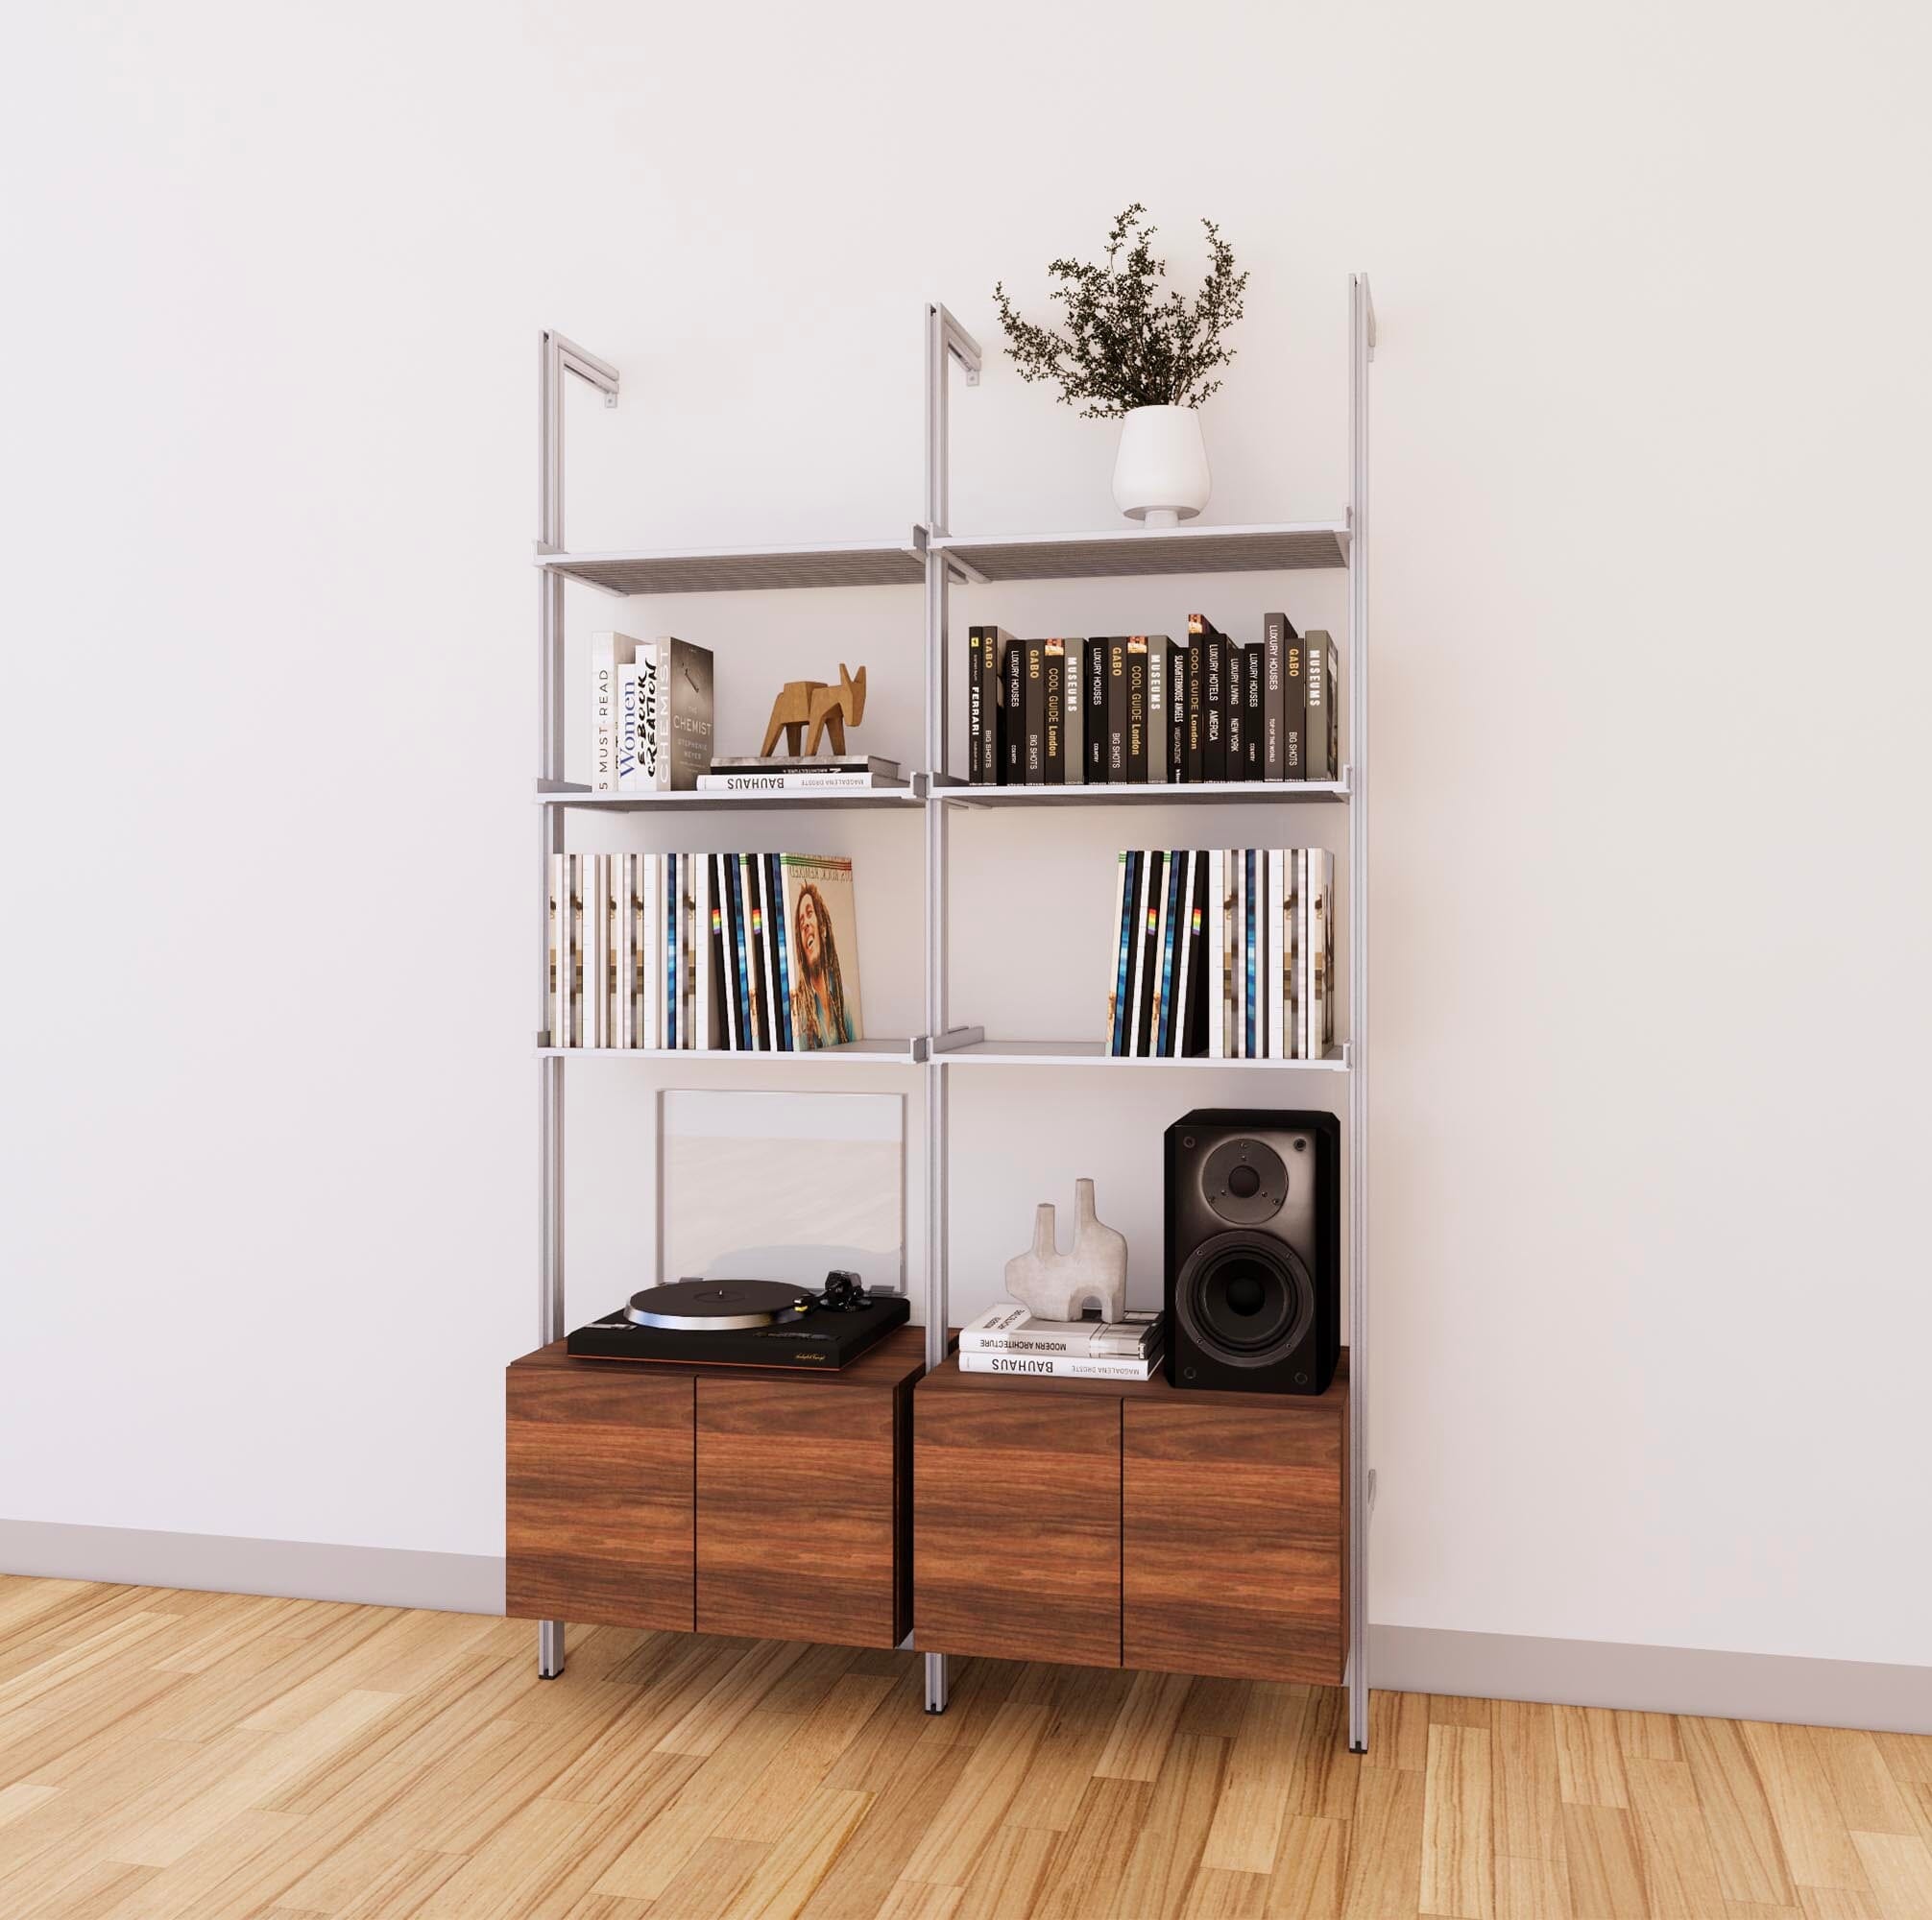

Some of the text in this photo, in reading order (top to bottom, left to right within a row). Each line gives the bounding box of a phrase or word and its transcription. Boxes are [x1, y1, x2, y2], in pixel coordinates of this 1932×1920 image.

[1011, 650, 1020, 708] LUXURY HOUSES
[1068, 657, 1077, 712] MUSEUMS
[1093, 647, 1101, 706] LUXURY HOUSES
[1151, 654, 1161, 710] MUSEUMS
[1174, 655, 1184, 702] SLAUGHTERHOUSE
[1249, 653, 1258, 708] LUXURY HOUSES
[1269, 625, 1278, 690] LUXURY HOUSES
[1310, 649, 1320, 707] MUSEUMS
[638, 671, 647, 765] E-BOOK
[645, 658, 658, 777] CREATION
[660, 647, 669, 782] CHEMIST
[1029, 649, 1039, 770] GABO BIG SHOTS
[1049, 668, 1058, 756] COOL GUIDE London
[1112, 647, 1122, 768] GABO BIG SHOTS
[1131, 665, 1142, 756] COOL GUIDE London
[1174, 702, 1184, 723] ANGELS
[1209, 644, 1219, 741] LUXURY HOTELS AMERICA
[1230, 658, 1239, 752] LUXURY LIVING NEW YORK
[1289, 648, 1298, 766] GABO BIG SHOTS
[620, 682, 635, 779] Women
[673, 715, 712, 735] CHEMIST
[727, 778, 785, 790] BAUHAUS
[979, 1339, 1067, 1352] MODERN ARCHITECTURE
[991, 1358, 1053, 1373] BAUHAUS
